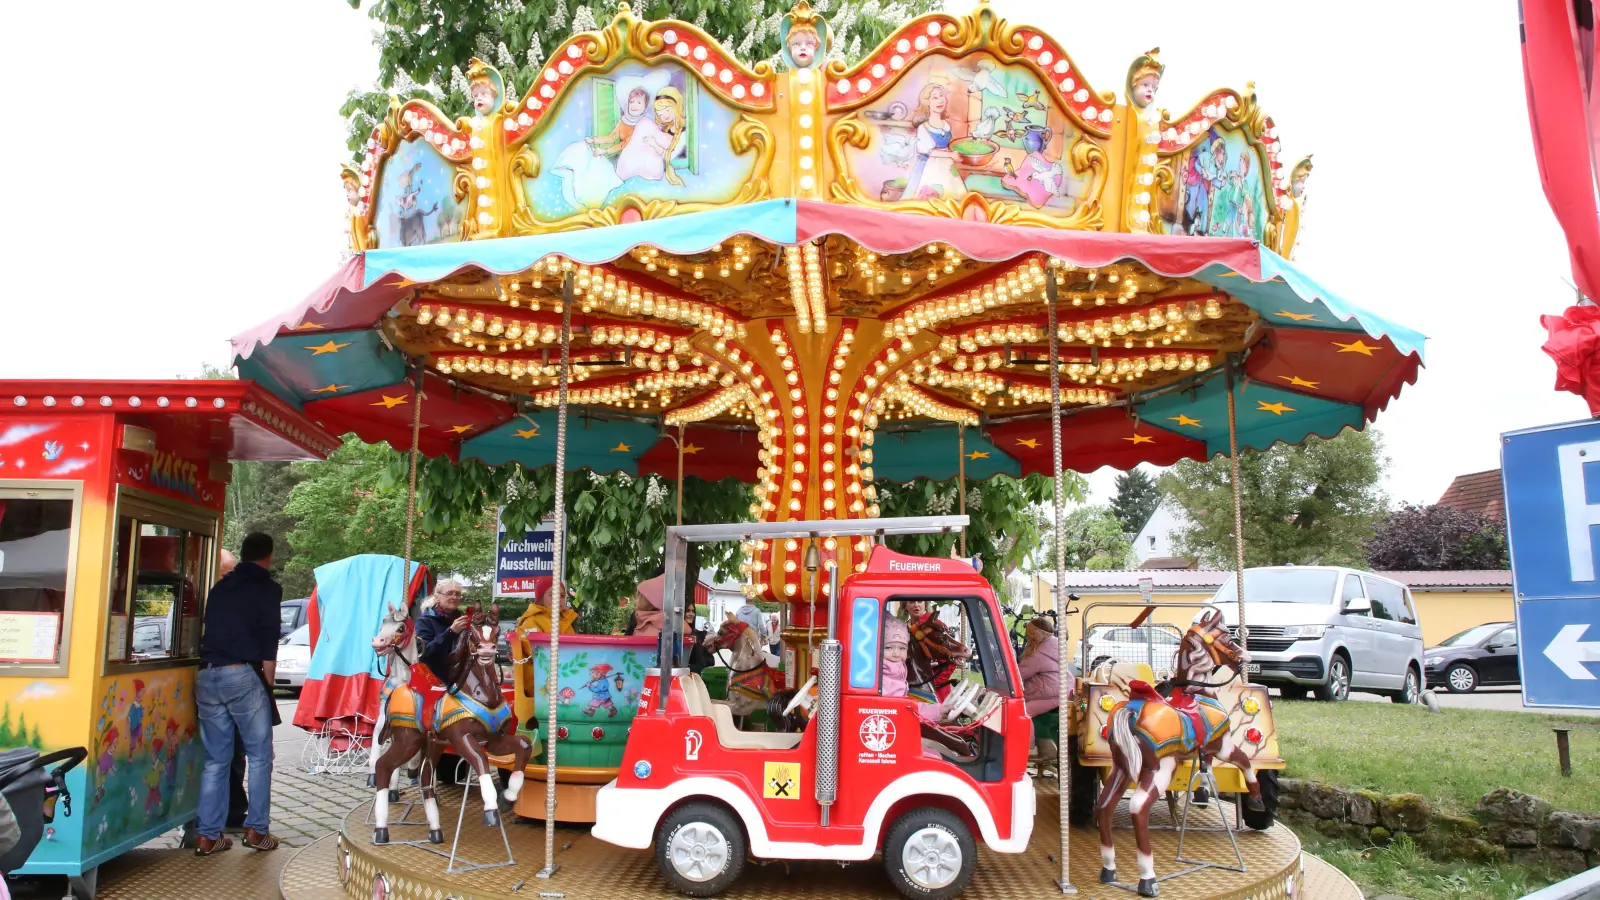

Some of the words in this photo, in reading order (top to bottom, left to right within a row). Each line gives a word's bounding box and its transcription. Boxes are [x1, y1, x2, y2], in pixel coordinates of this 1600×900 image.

[150, 449, 198, 496] KASSE
[500, 556, 555, 571] Ausstellun
[521, 580, 535, 590] Mai
